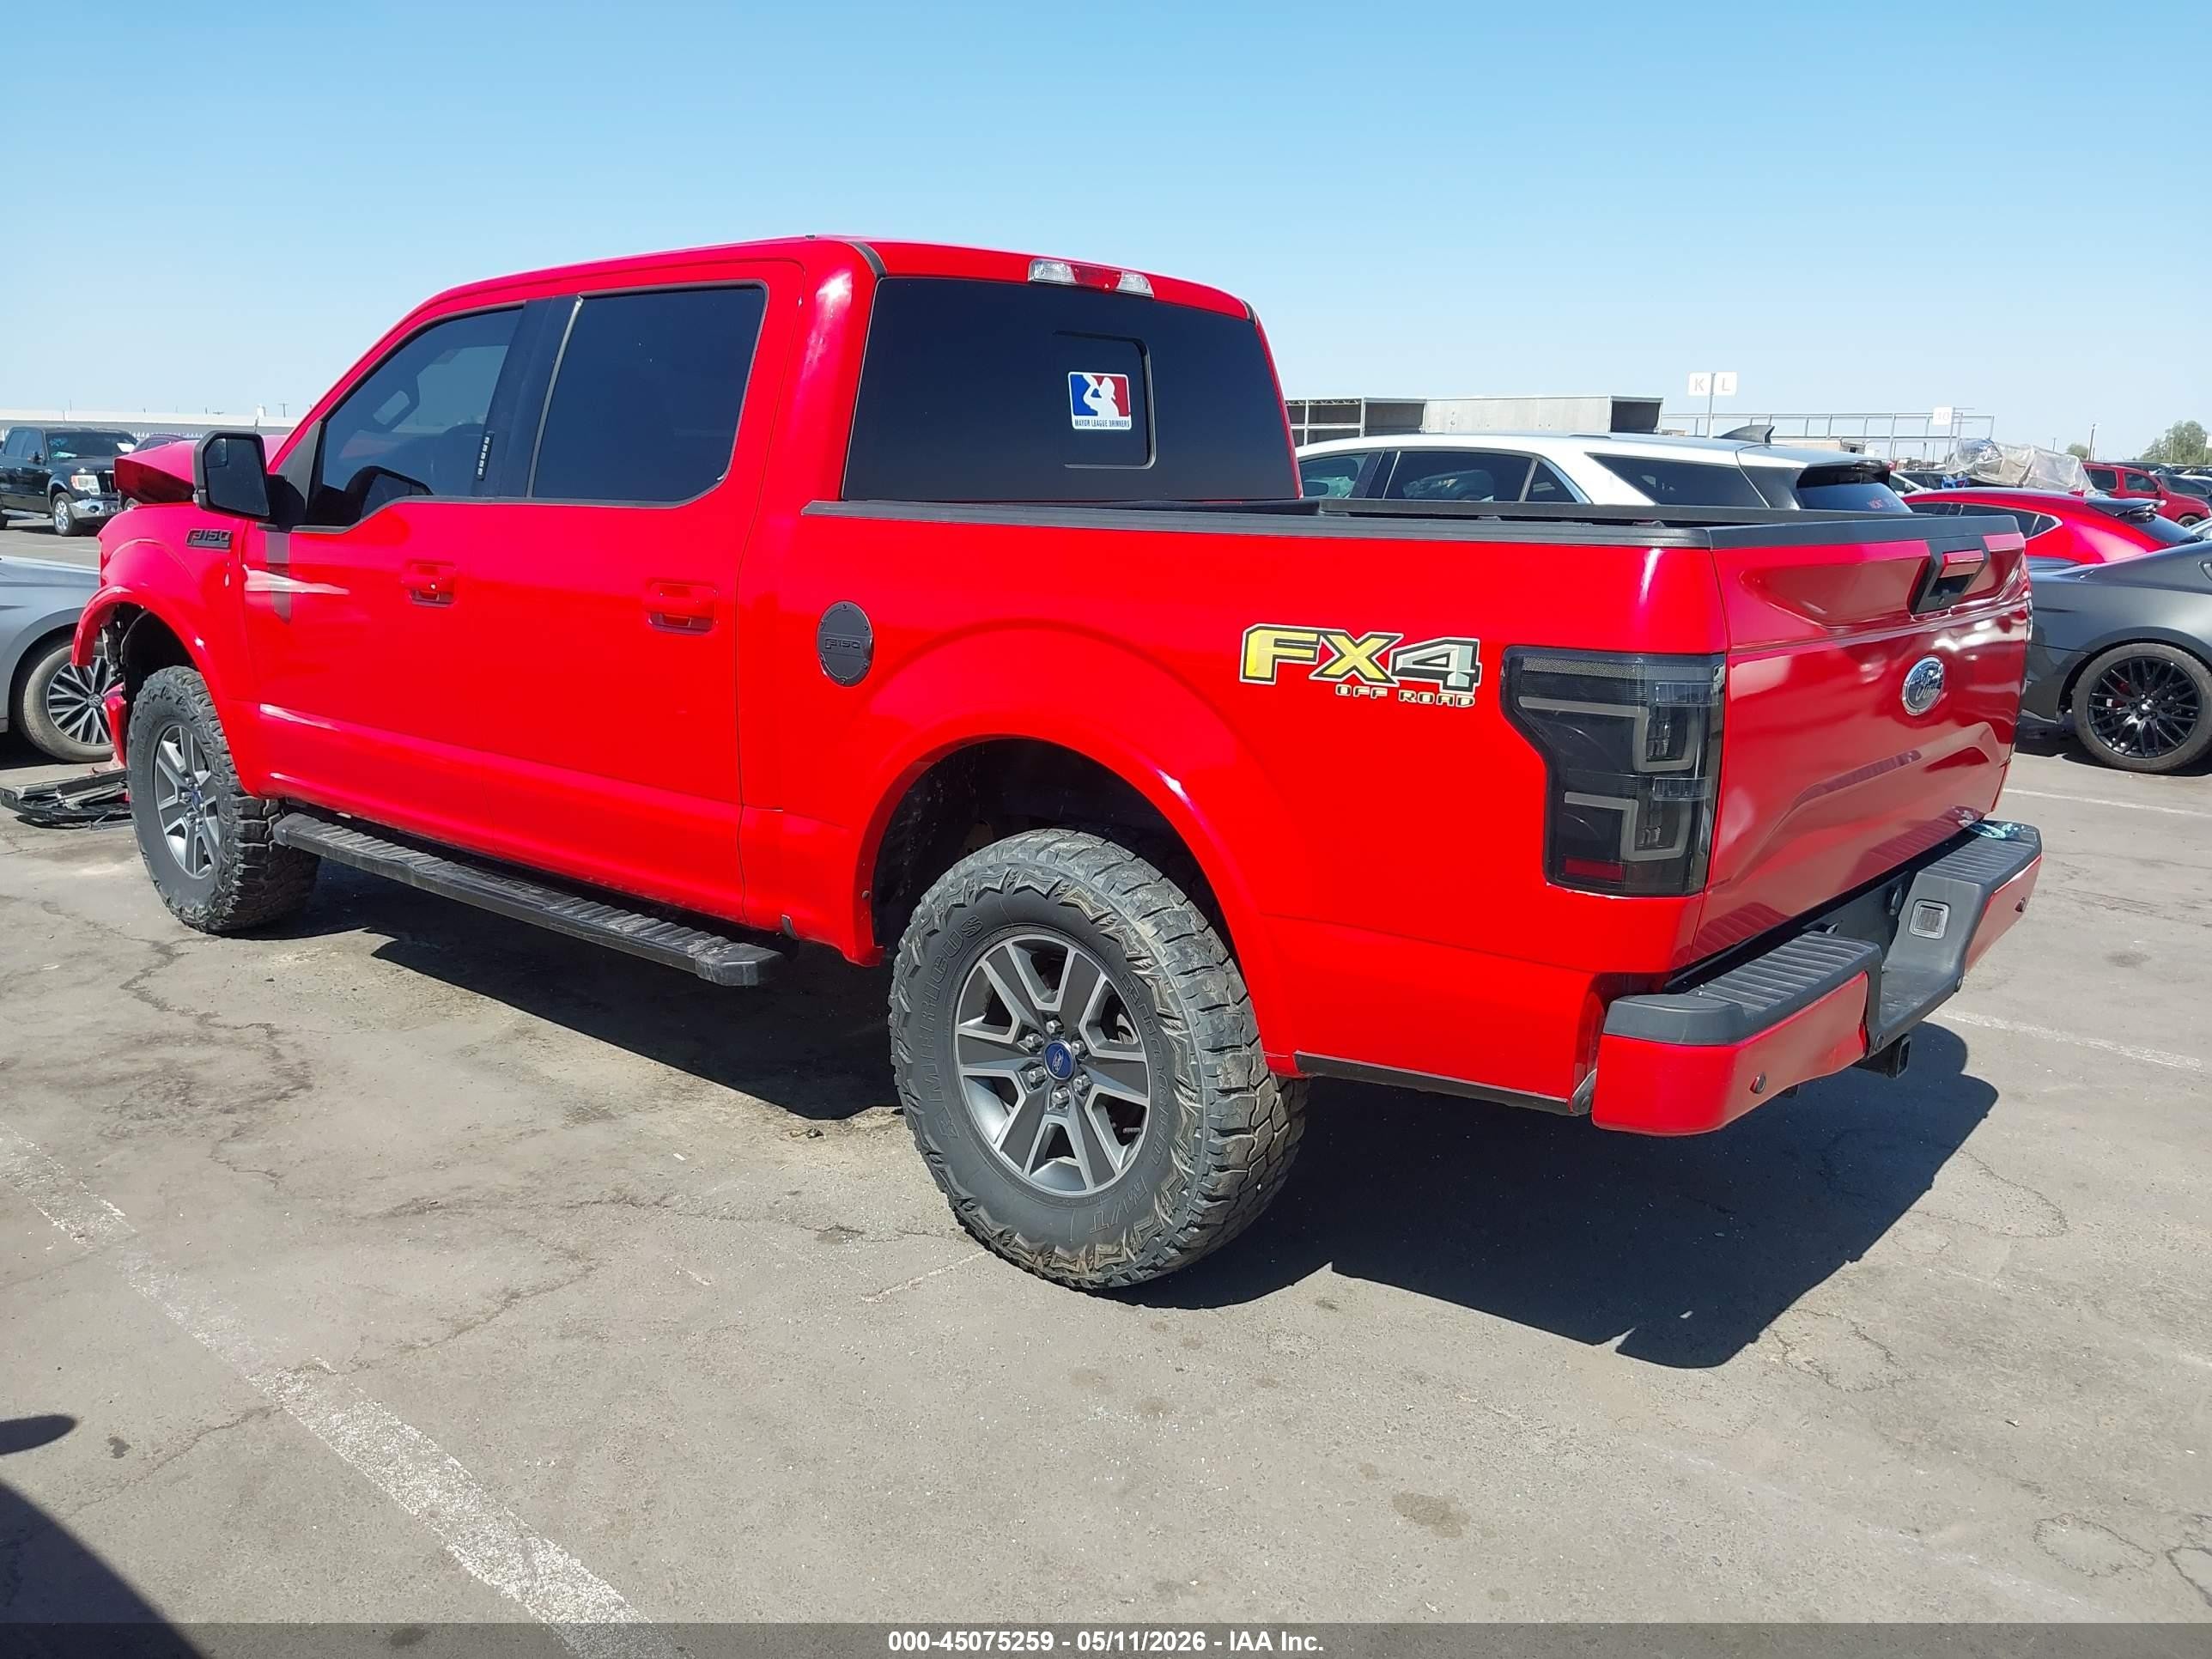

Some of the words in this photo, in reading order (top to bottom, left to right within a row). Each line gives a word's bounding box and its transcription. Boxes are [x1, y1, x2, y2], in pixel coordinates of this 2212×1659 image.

[1694, 377, 1705, 392] K
[1722, 377, 1732, 392] L
[1091, 419, 1108, 428] LEAGUE
[1239, 623, 1483, 695] FX4
[1335, 684, 1389, 700] OFF
[1398, 689, 1476, 708] ROAD
[920, 914, 984, 1139] AMERICUS
